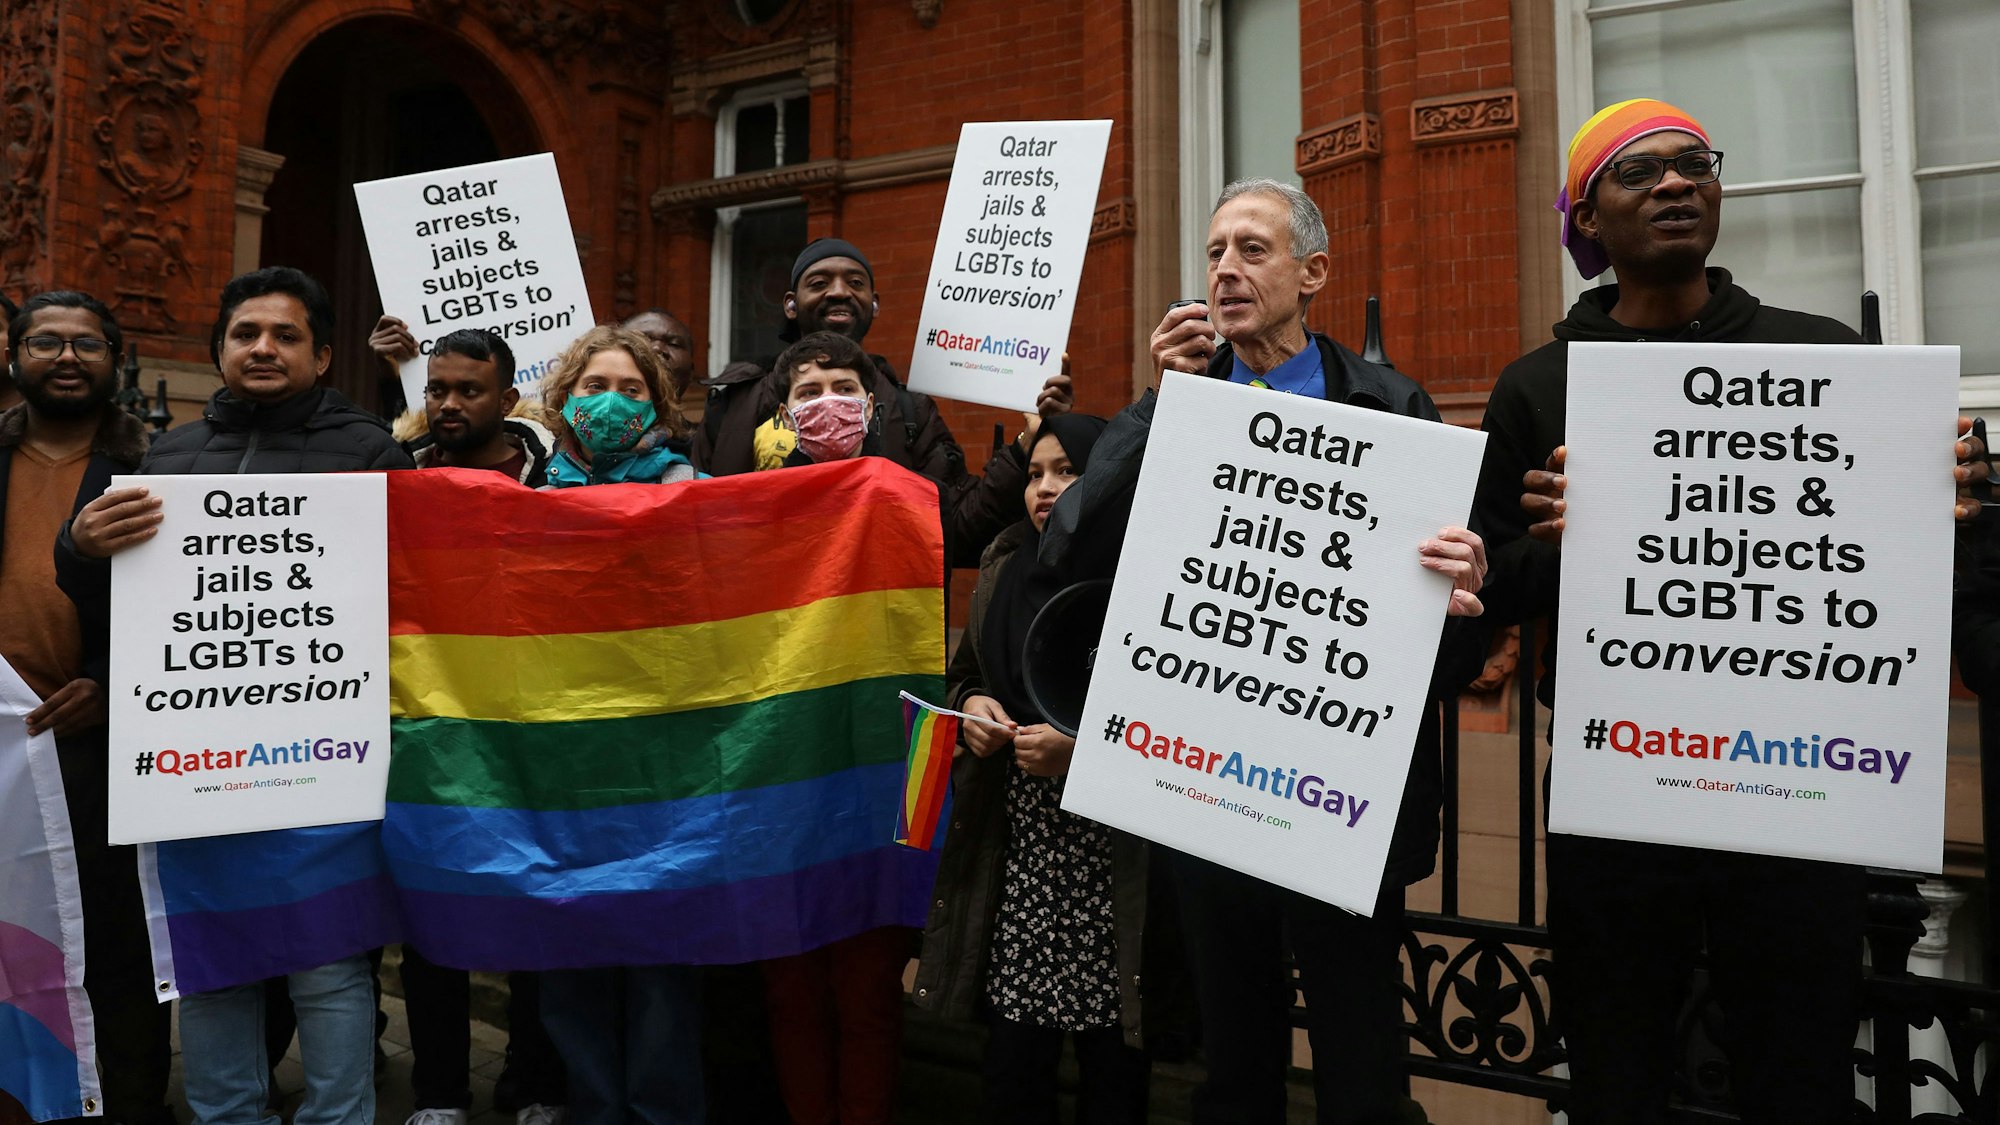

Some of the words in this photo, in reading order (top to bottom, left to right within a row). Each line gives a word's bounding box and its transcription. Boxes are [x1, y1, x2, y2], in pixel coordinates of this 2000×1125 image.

[999, 135, 1058, 159] Qatar
[422, 178, 499, 206] Qatar
[982, 165, 1060, 192] arrests,
[414, 204, 521, 238] arrests,
[979, 193, 1025, 221] jails
[1030, 194, 1047, 218] &
[430, 236, 489, 271] jails
[497, 229, 519, 252] &
[964, 223, 1054, 252] subjects
[421, 257, 540, 296] subjects
[954, 250, 1025, 278] LGBTs
[1030, 256, 1052, 280] to
[421, 289, 519, 326] LGBTs
[524, 284, 553, 305] to
[936, 278, 1064, 311] ‘conversion’
[925, 327, 1051, 366] #QatarAntiGay
[948, 360, 1015, 375] www.QatarAntiGay.com
[1682, 365, 1833, 409] Qatar
[1248, 411, 1374, 468] Qatar
[1652, 423, 1855, 472] arrests,
[203, 489, 309, 520] Qatar
[1212, 463, 1379, 532] arrests,
[1664, 472, 1777, 522] jails
[1796, 476, 1837, 518] &
[181, 526, 325, 558] arrests,
[1209, 504, 1307, 559] jails
[1320, 530, 1354, 572] &
[1636, 527, 1866, 579] subjects
[192, 564, 274, 602] jails
[286, 562, 314, 591] &
[1179, 556, 1370, 628] subjects
[171, 600, 335, 638] subjects
[1624, 576, 1805, 626] LGBTs
[1823, 588, 1878, 630] to
[163, 638, 296, 673] LGBTs
[307, 637, 344, 665] to
[1159, 592, 1309, 665] LGBTs
[1324, 637, 1369, 681] to
[1585, 627, 1917, 687] ‘conversion’
[133, 670, 370, 713] ‘conversion’
[1122, 631, 1395, 739] ‘conversion’
[134, 737, 371, 777] #QatarAntiGay
[1103, 713, 1371, 829] #QatarAntiGay
[1582, 718, 1912, 785] #QatarAntiGay
[193, 776, 317, 794] www.QatarAntiGay.com
[1154, 777, 1293, 831] www.QatarAntiGay.com
[1655, 776, 1827, 802] www.QatarAntiGay.com
